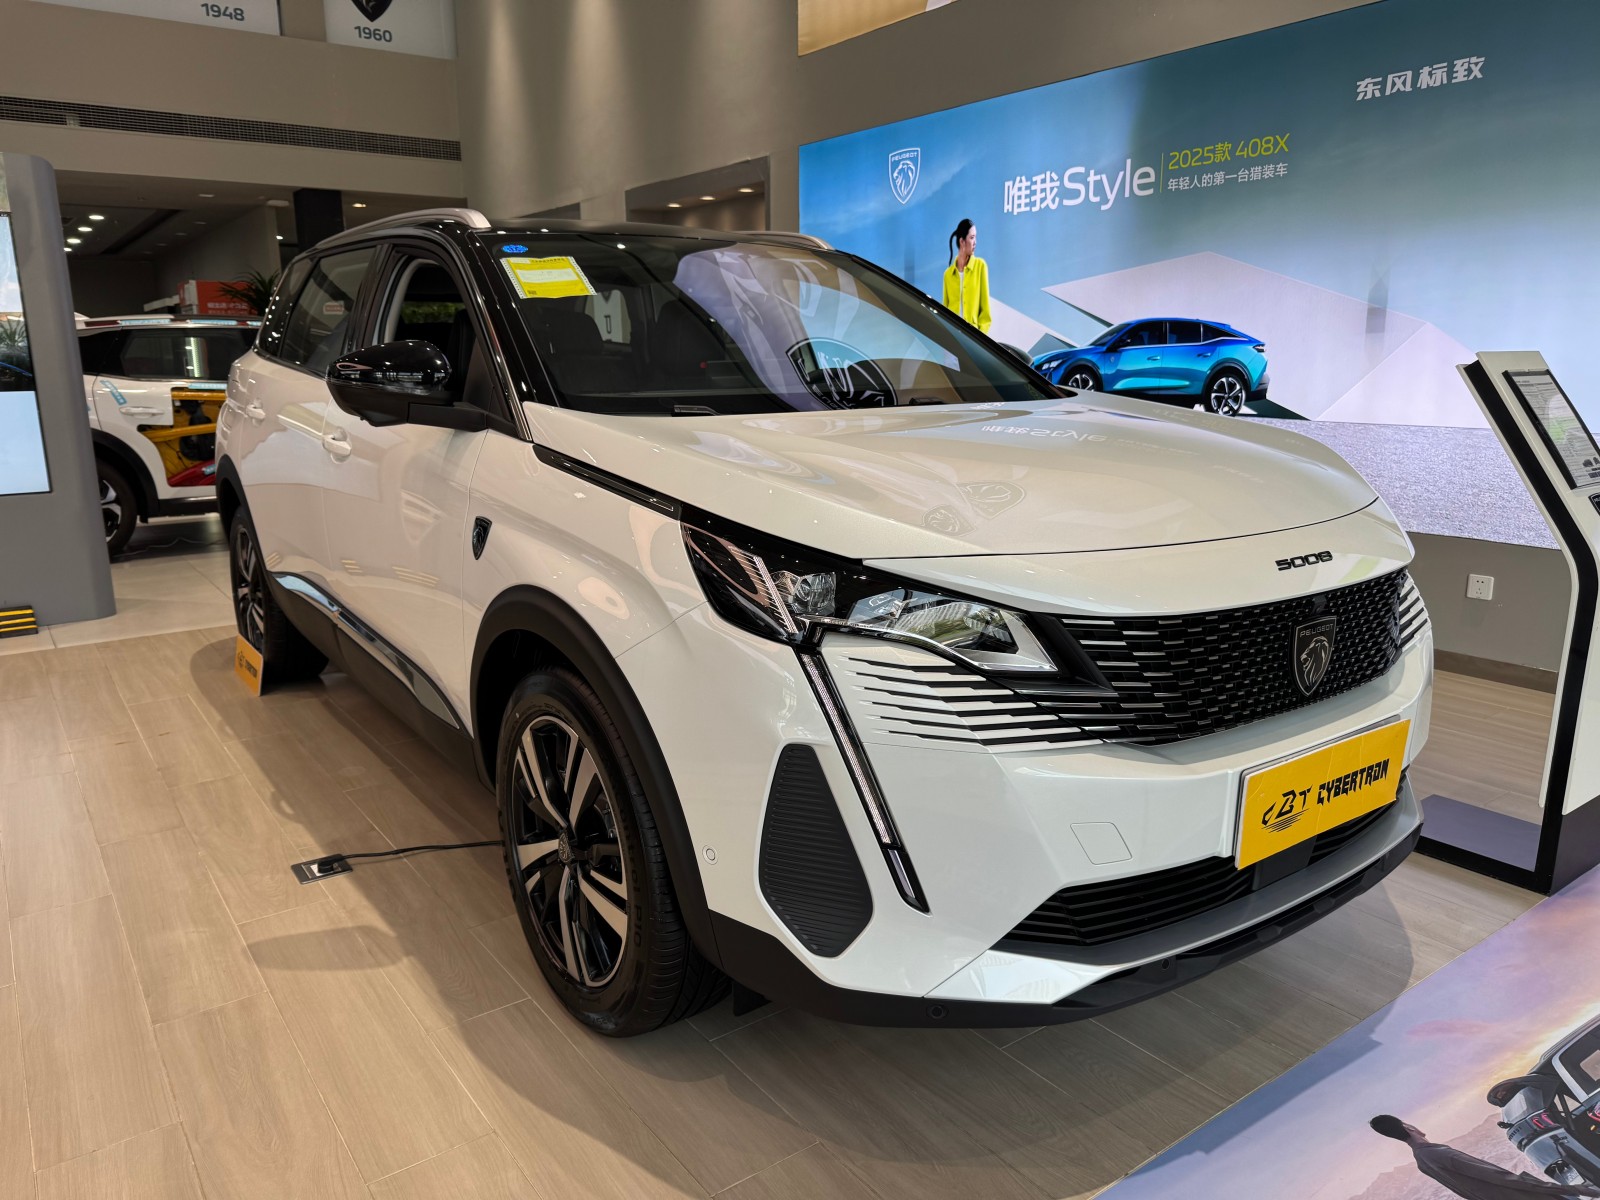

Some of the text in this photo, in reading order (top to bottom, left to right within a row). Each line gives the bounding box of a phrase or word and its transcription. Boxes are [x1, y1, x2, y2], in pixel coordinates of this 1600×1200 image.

[200, 2, 245, 22] 1948
[354, 25, 392, 43] 1960
[1356, 56, 1486, 101] 东风标致
[891, 151, 917, 162] PEUGEOT
[1168, 132, 1290, 170] 2025款 408X
[1003, 158, 1155, 216] 唯我Style
[1167, 162, 1288, 192] 年轻人的第一台猎装车
[1275, 550, 1333, 572] 5008
[1300, 623, 1333, 638] PEUGEOT
[1316, 758, 1390, 806] CYBERTRON
